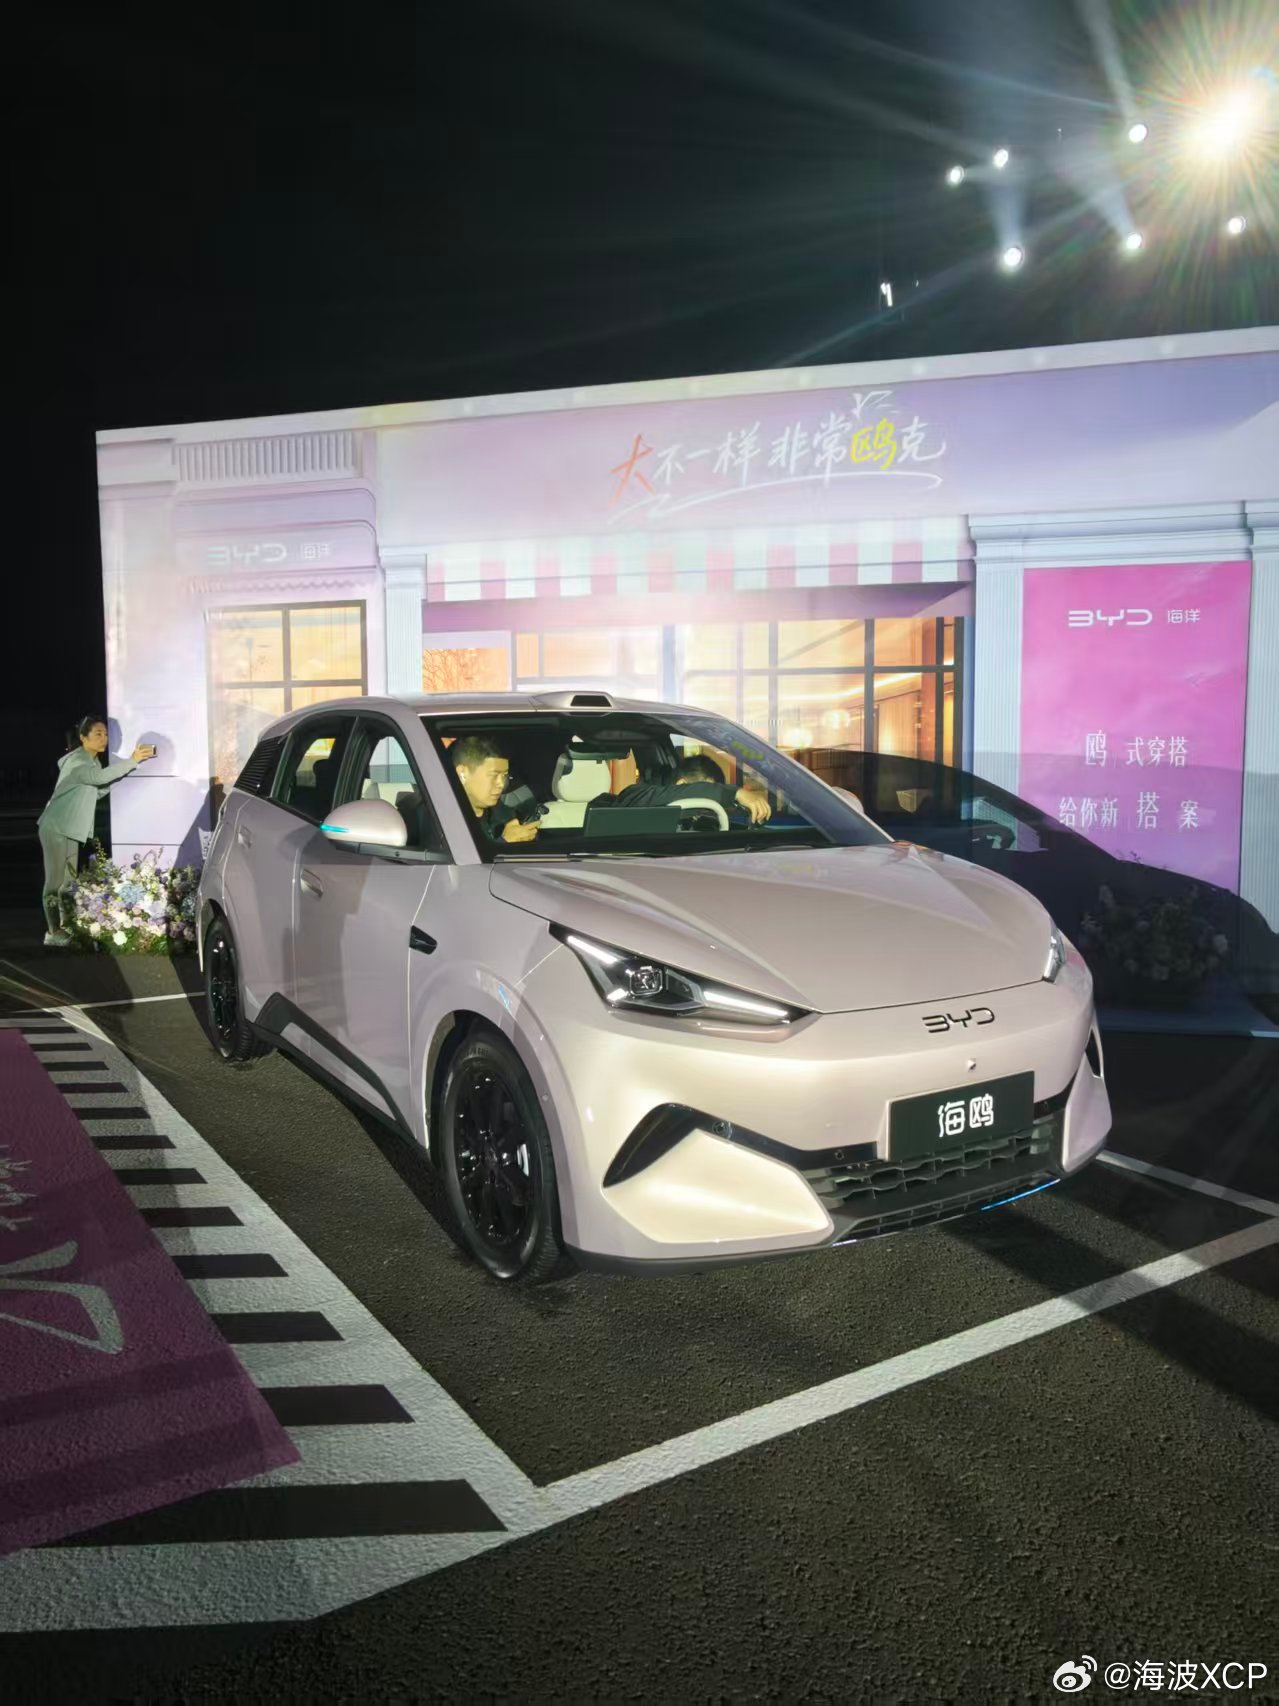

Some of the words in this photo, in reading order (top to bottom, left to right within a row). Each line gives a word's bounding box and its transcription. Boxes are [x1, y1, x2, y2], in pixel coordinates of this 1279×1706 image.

[208, 543, 287, 565] BYD
[1068, 609, 1153, 628] BYD
[1167, 608, 1201, 624] 海洋
[922, 1007, 996, 1034] BYD
[937, 1093, 995, 1138] 海鸥
